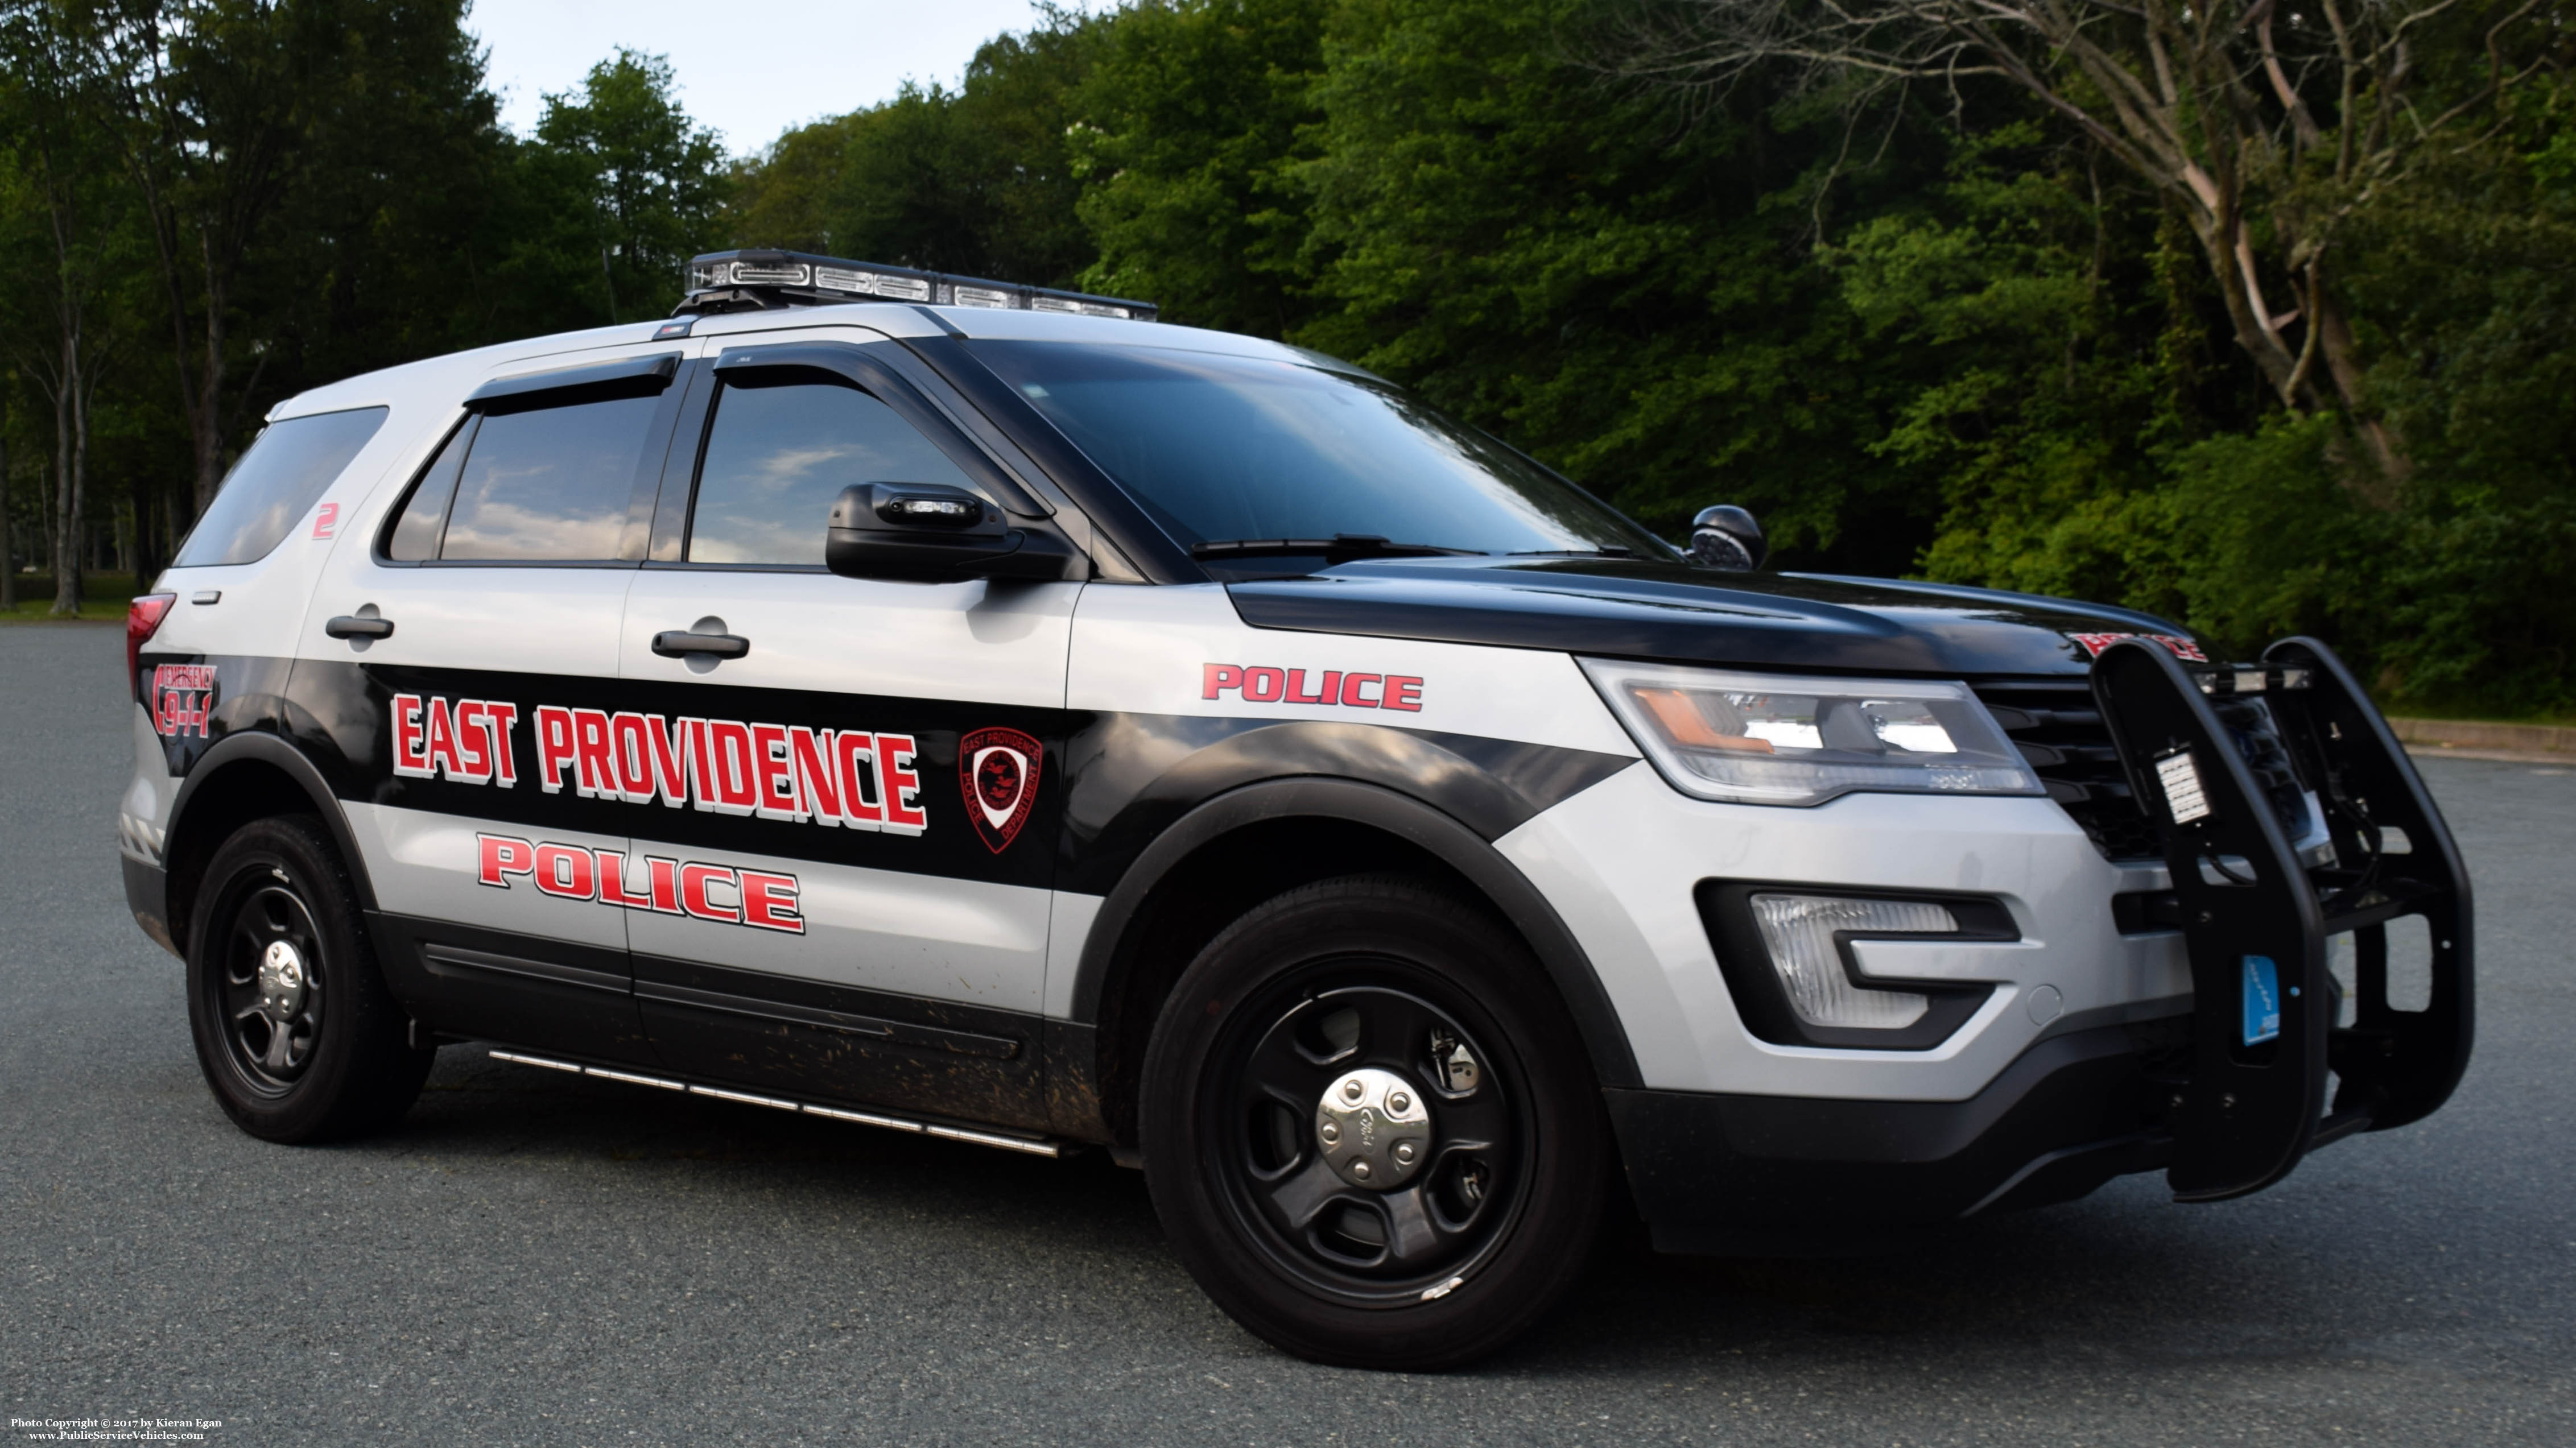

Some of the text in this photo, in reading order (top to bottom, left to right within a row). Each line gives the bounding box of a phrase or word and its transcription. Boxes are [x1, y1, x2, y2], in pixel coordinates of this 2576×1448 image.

[311, 503, 339, 541] 2
[165, 665, 215, 690] EMERGENCY
[1202, 663, 1424, 713] POLICE
[164, 691, 213, 738] 9-1-1
[391, 694, 518, 788] EAST
[534, 705, 927, 838] PROVIDENCE
[964, 732, 1039, 760] EAST PROVIDENCE
[963, 772, 984, 824] POLICE
[1001, 765, 1037, 840] DEPARTMENT
[476, 832, 806, 936] POLICE
